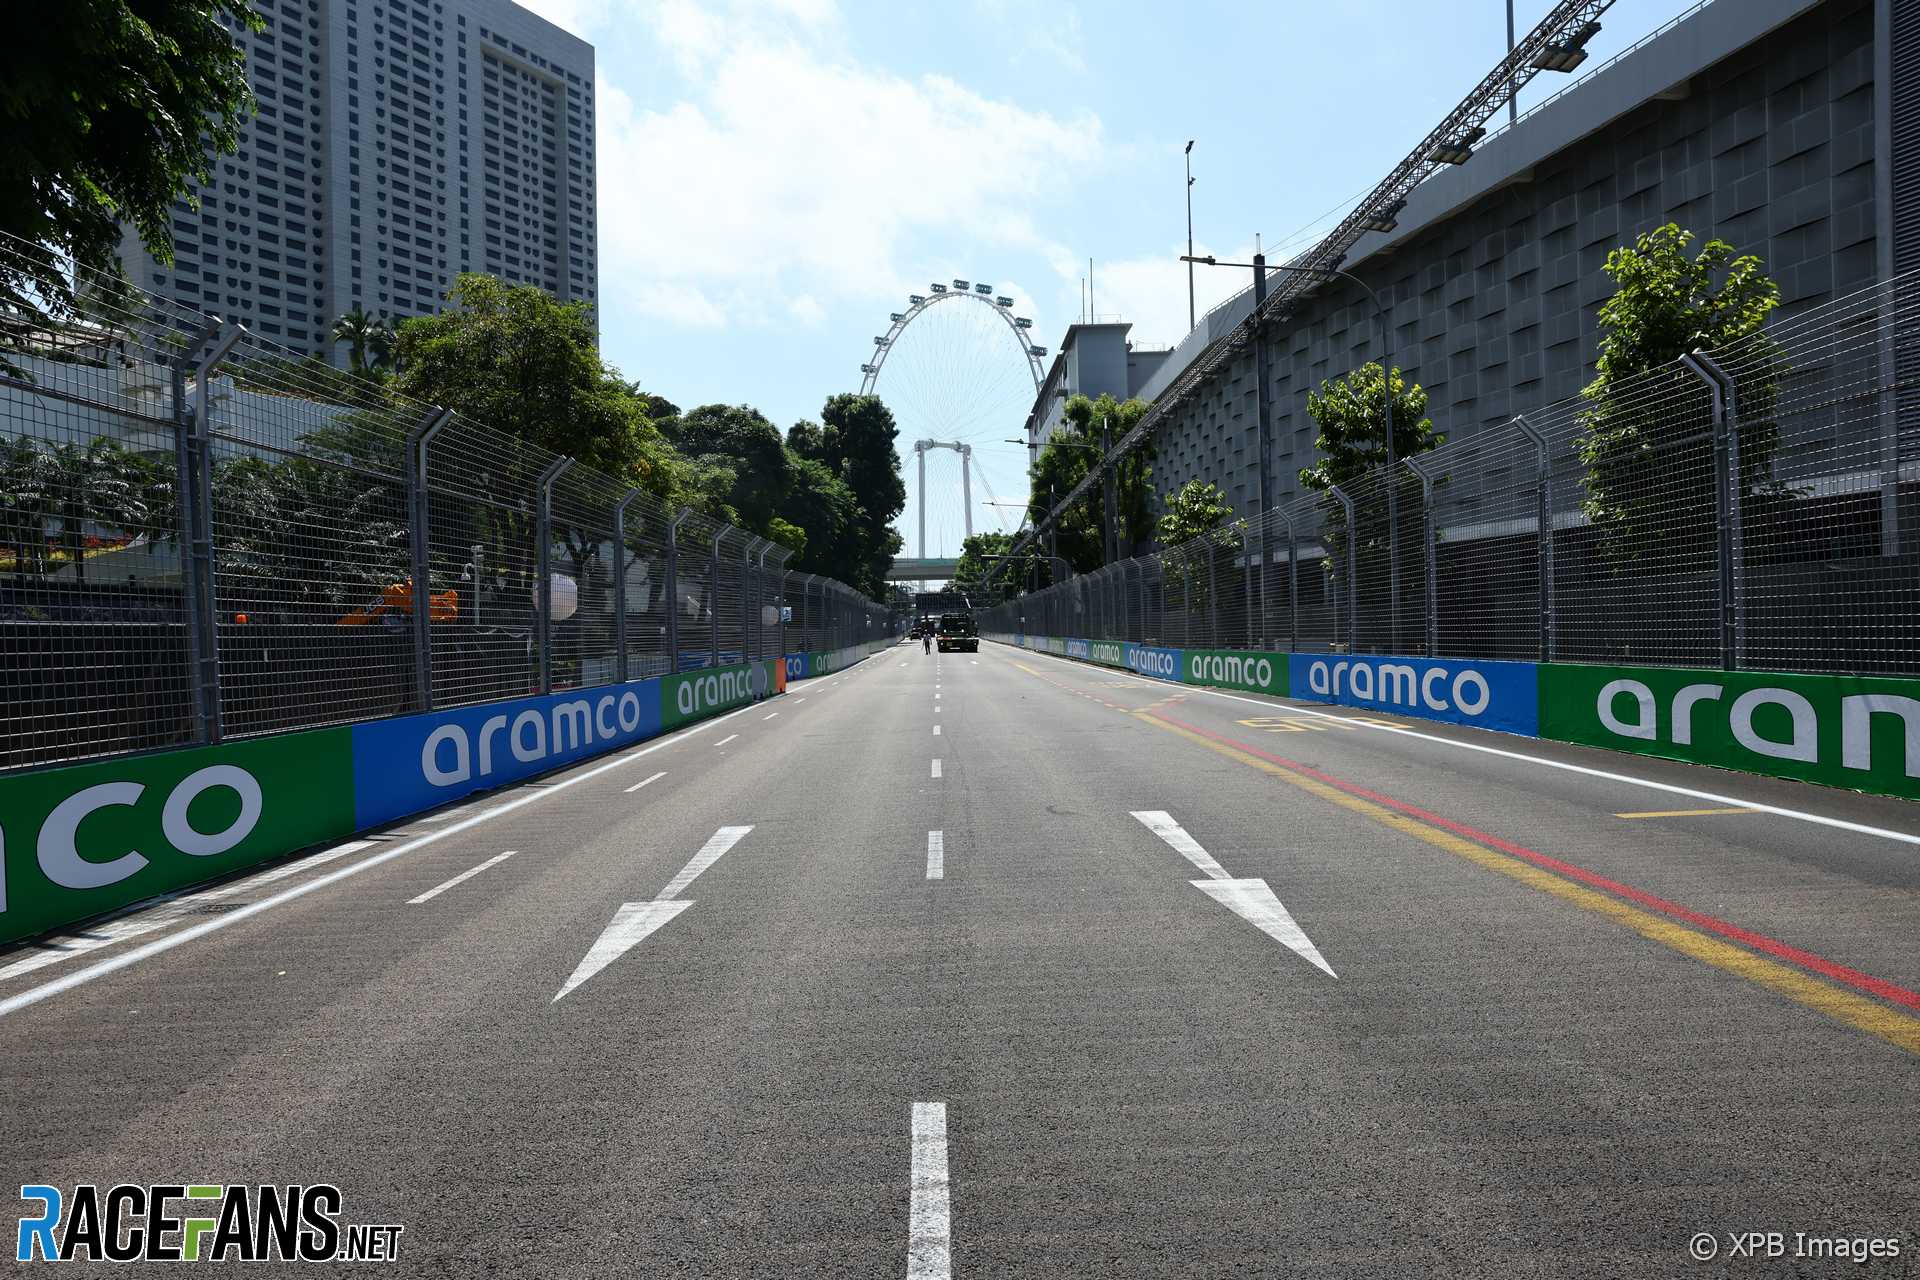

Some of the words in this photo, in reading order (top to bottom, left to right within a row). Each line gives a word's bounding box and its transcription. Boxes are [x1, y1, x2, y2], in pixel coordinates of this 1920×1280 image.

[1092, 644, 1120, 662] aramco
[1129, 648, 1174, 674] aramco
[1191, 655, 1272, 688] aramco
[1309, 660, 1490, 716] aramco
[421, 691, 641, 787] aramco
[0, 764, 263, 912] co
